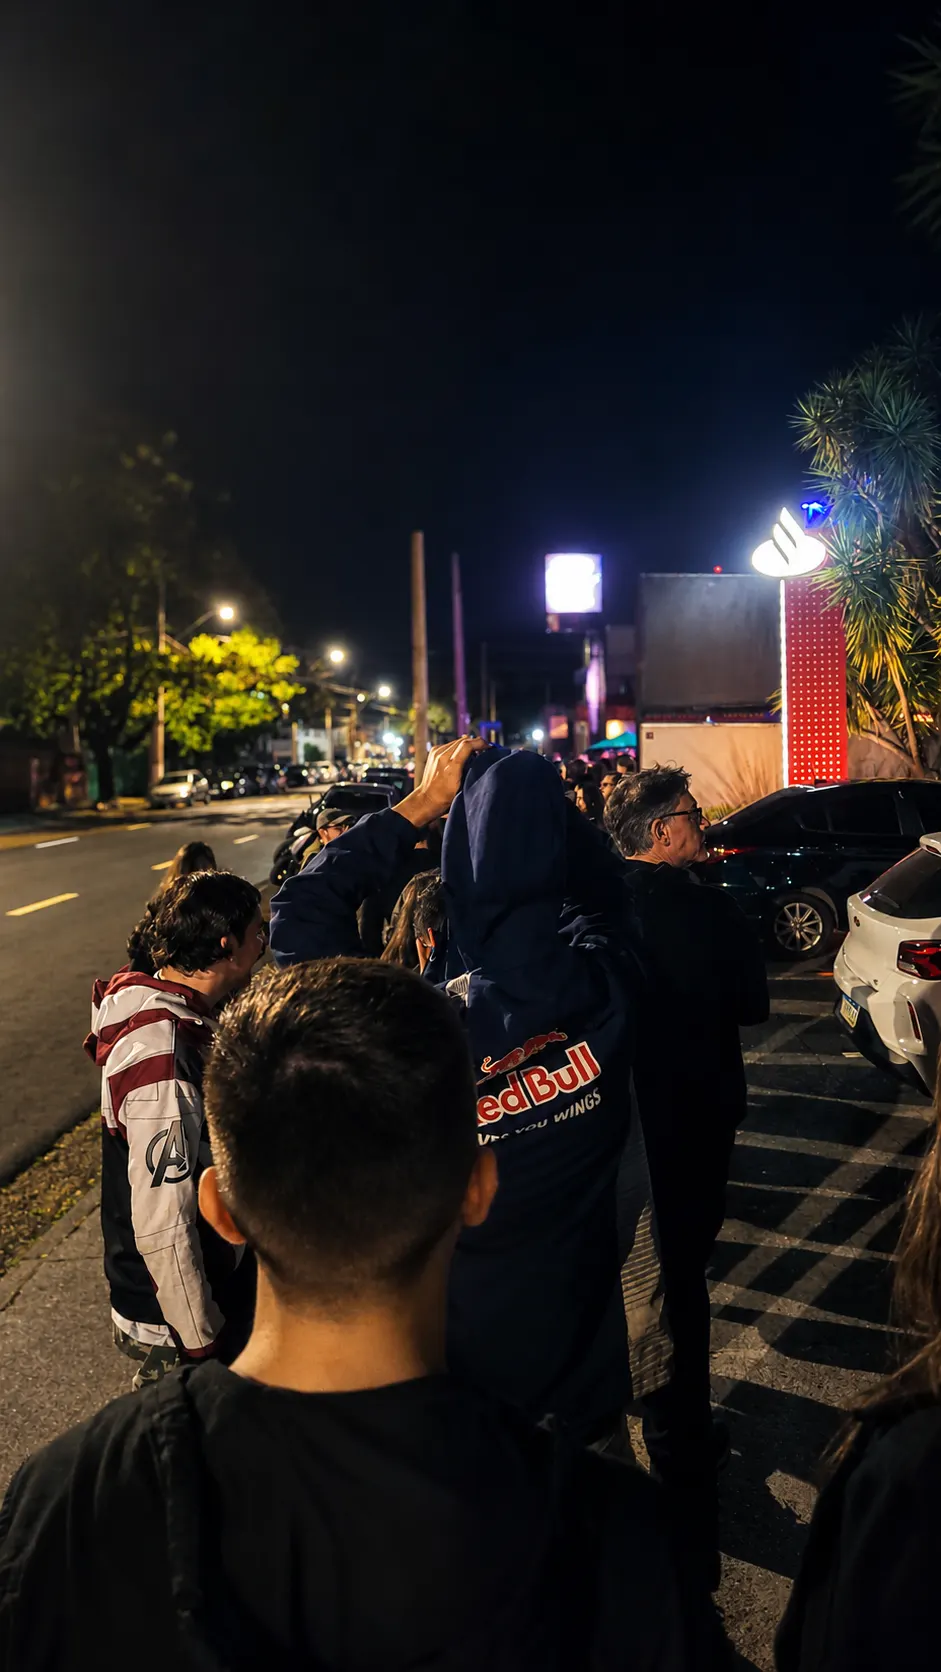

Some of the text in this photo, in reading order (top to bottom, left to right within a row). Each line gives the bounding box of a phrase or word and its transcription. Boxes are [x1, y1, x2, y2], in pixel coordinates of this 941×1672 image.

[477, 1041, 602, 1127] ed Bull
[515, 1119, 548, 1135] YOU
[553, 1087, 602, 1123] WINGS
